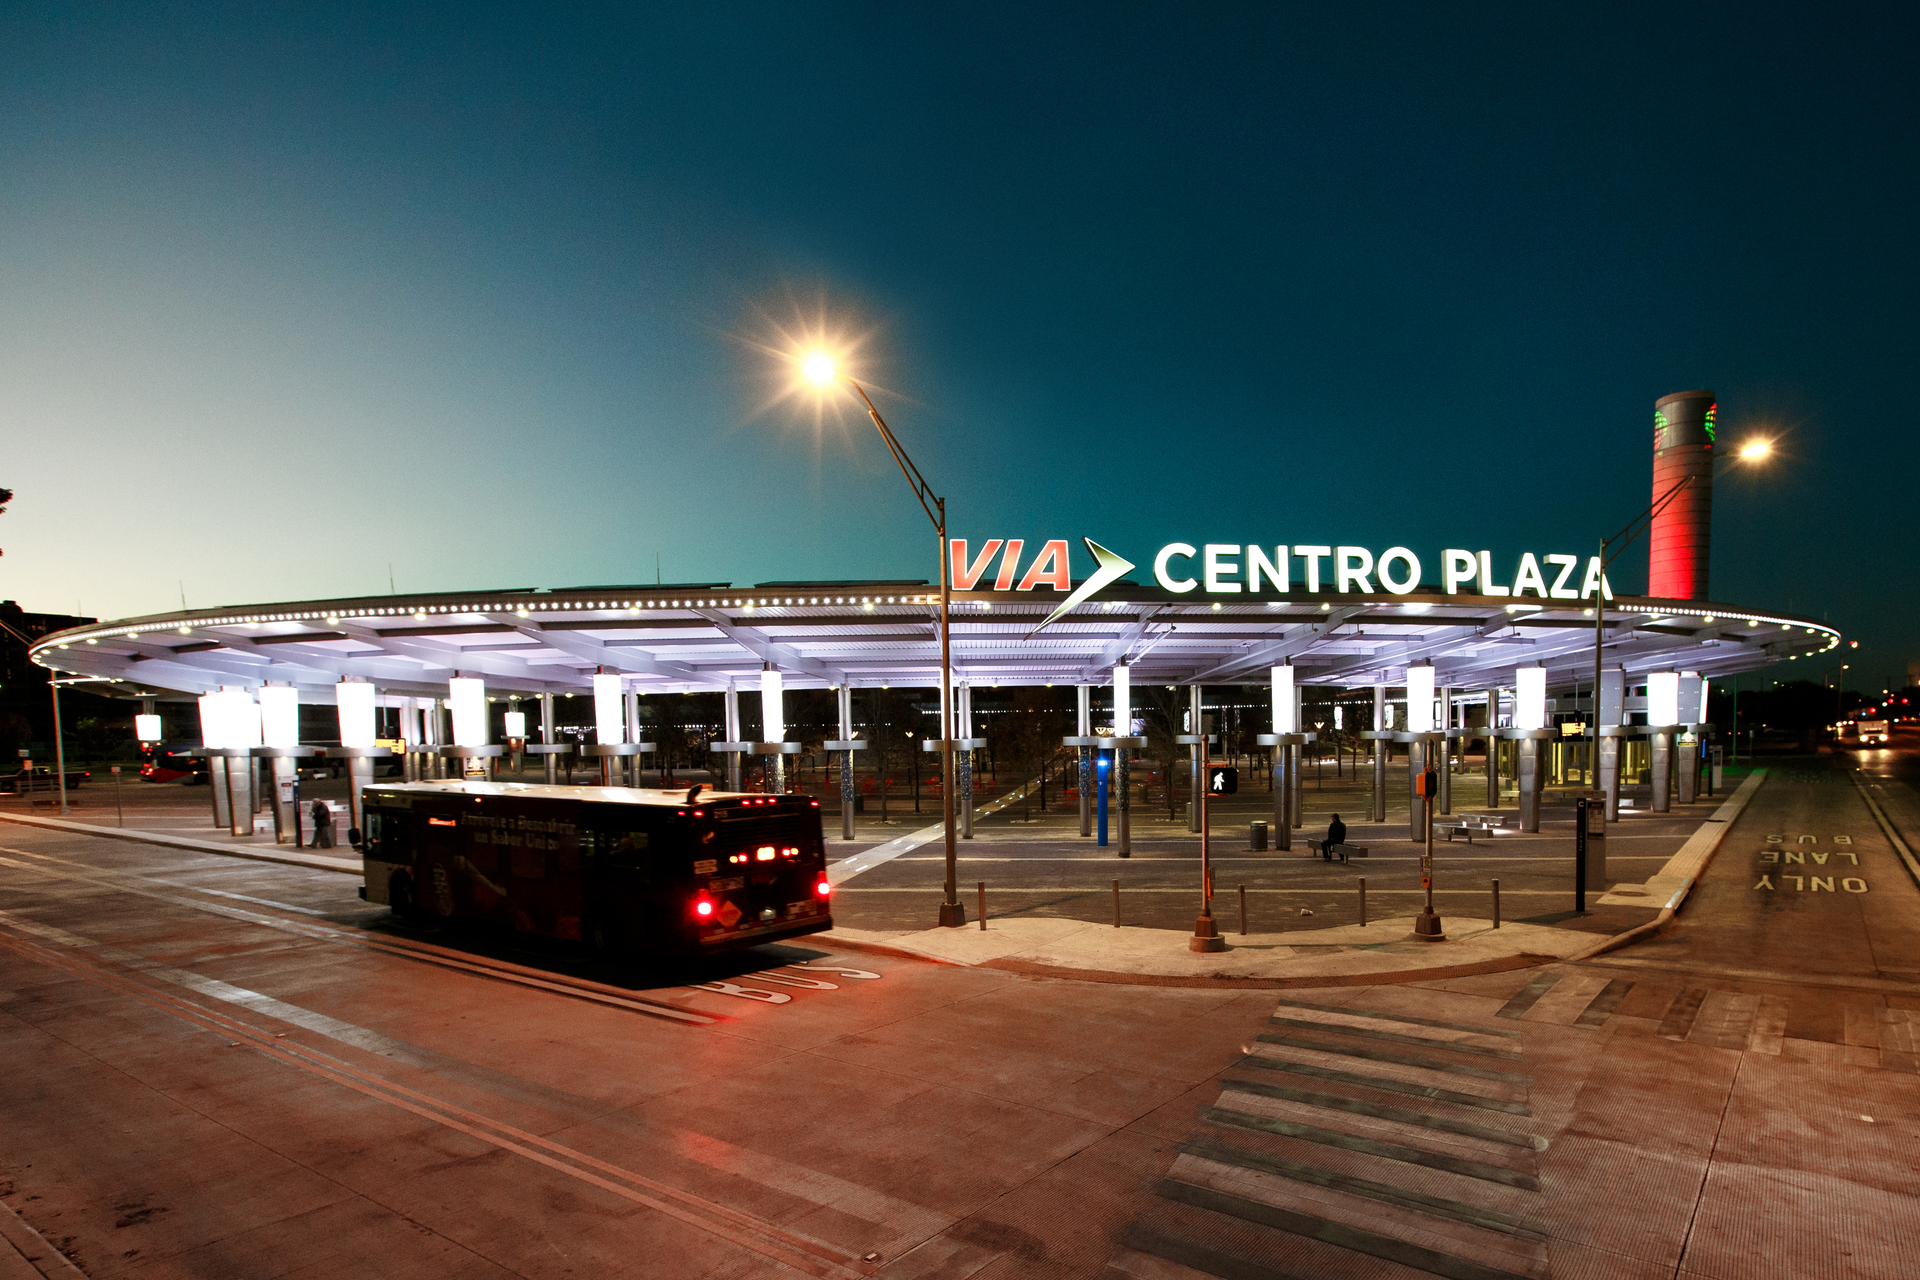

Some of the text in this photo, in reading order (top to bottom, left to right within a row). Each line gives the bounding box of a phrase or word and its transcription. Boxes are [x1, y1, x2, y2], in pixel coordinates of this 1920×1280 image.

[949, 538, 1614, 601] VIA CENTRO PLAZA
[1766, 834, 1853, 845] BUS
[1758, 851, 1860, 866] LANE
[1753, 874, 1869, 894] ONLY
